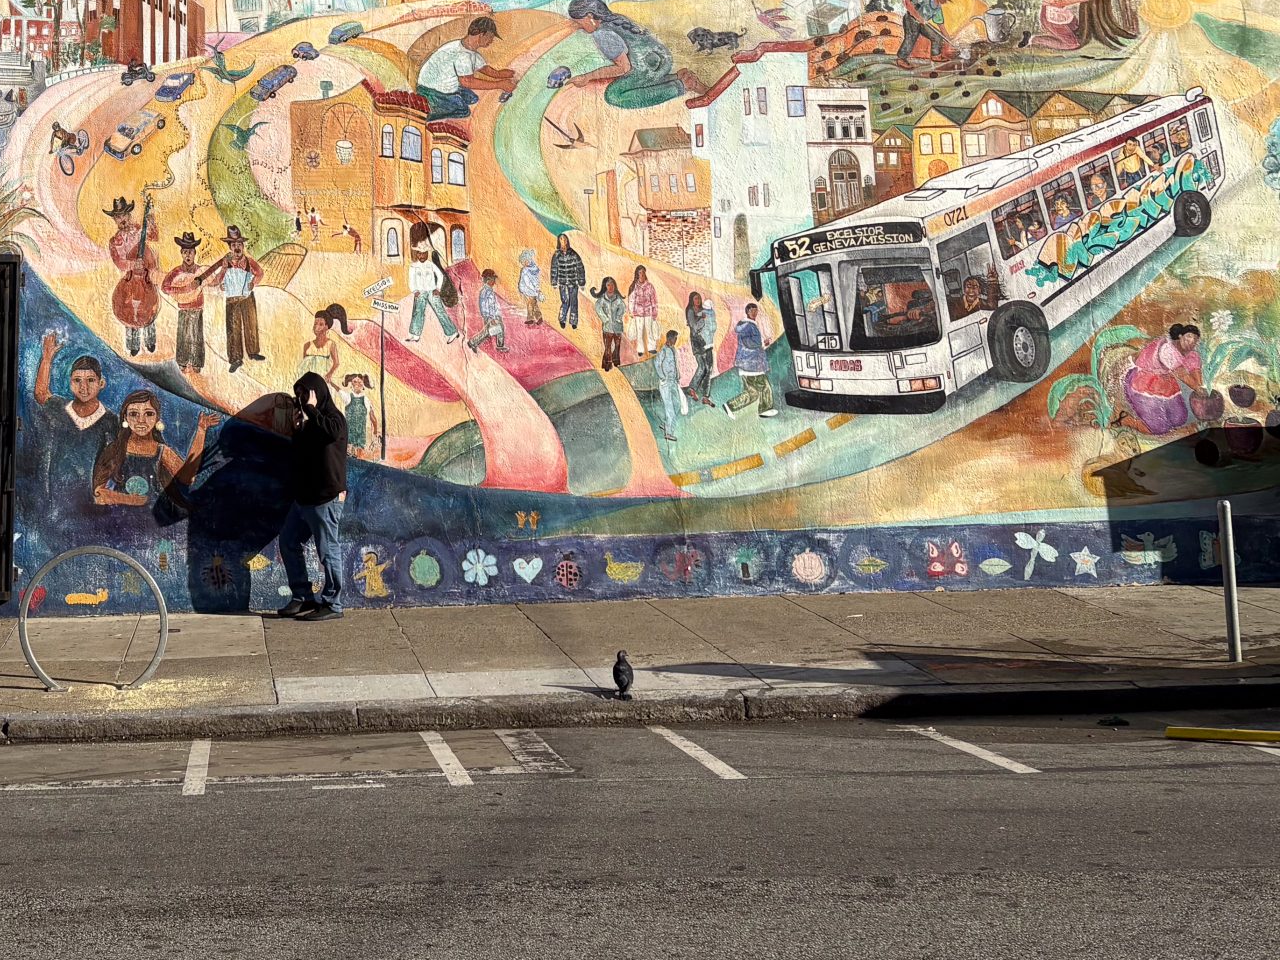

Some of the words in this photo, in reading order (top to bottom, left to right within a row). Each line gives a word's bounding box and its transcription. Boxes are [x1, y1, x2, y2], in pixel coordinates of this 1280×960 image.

[943, 205, 970, 227] 0721
[812, 233, 914, 254] GENEVA/MISSION
[826, 225, 885, 241] EXCELSIOR
[785, 236, 813, 259] 52
[372, 299, 399, 311] MISSION
